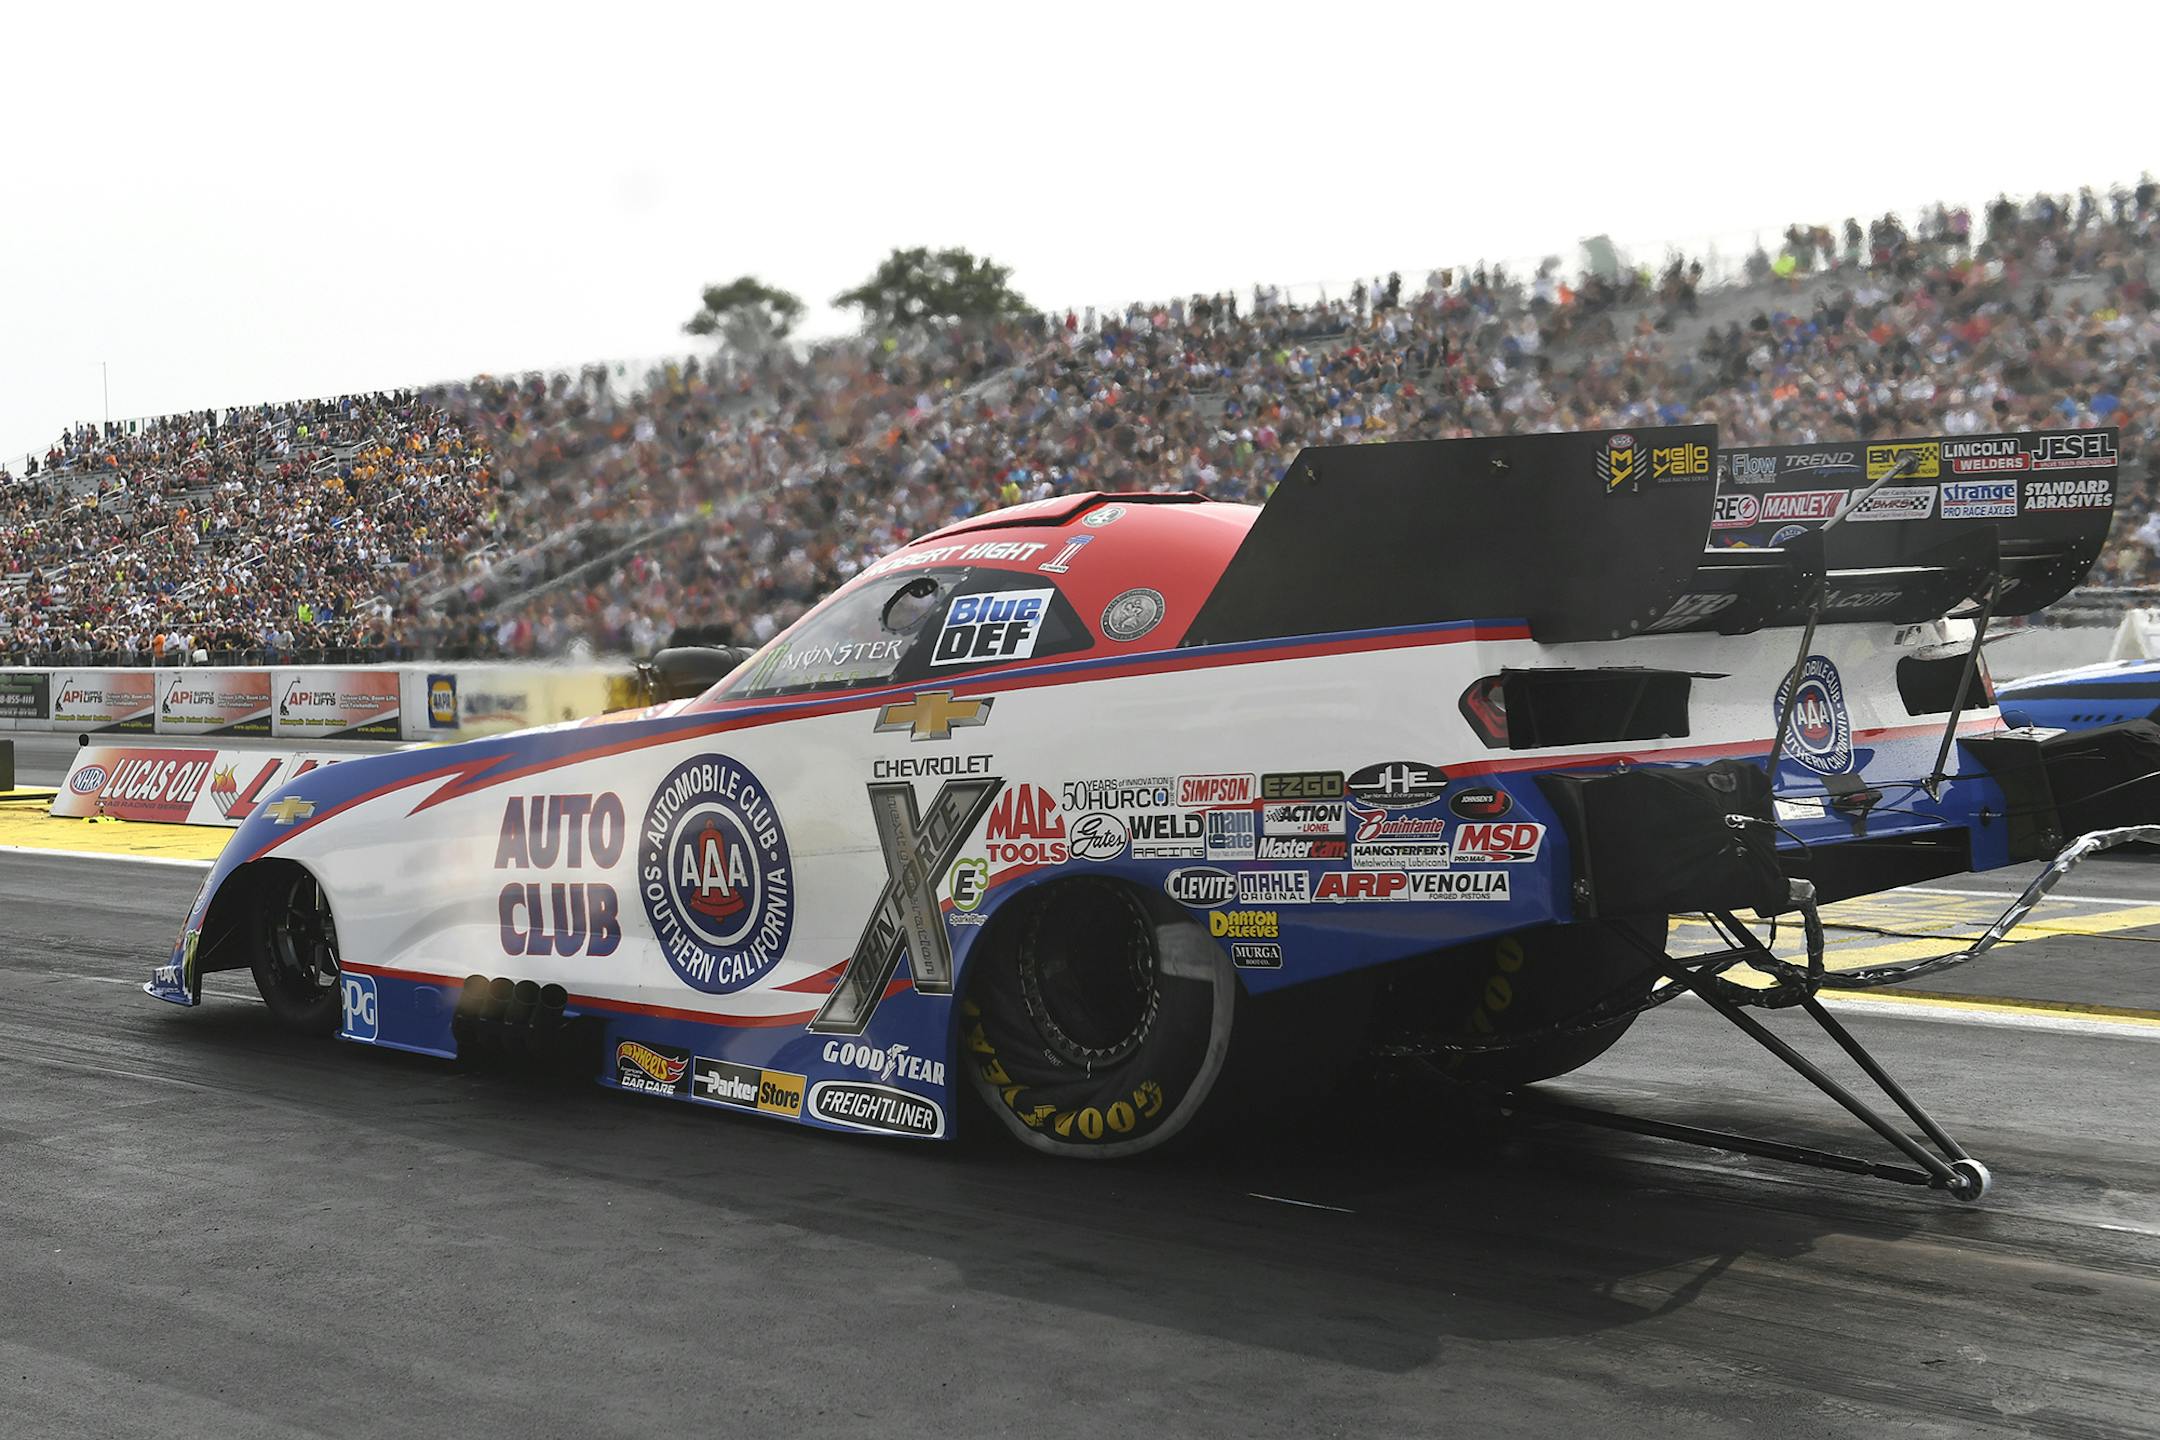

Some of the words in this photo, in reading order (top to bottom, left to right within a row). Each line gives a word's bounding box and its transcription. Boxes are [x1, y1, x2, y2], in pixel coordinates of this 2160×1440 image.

[1945, 441, 2015, 458] LINCOLN
[2031, 433, 2118, 460] JESEL
[1732, 453, 1777, 476] Flow
[1785, 452, 1855, 467] TREND
[1960, 457, 2023, 471] WELDERS
[2024, 480, 2110, 496] STANDARD
[1764, 495, 1832, 518] MANLEY
[1943, 506, 1961, 518] PRO
[1962, 505, 1986, 517] RACE
[1986, 504, 2016, 516] AXLES
[2024, 493, 2113, 510] ABRASIVES
[960, 542, 1049, 561] HIGHT
[948, 597, 1043, 626] Blue
[935, 621, 1032, 661] DEF
[193, 696, 215, 705] LIFTS
[313, 697, 337, 706] LIFTS
[1797, 700, 1831, 730] AAA
[873, 754, 994, 779] CHEVROLET
[73, 768, 105, 791] NHRA
[99, 758, 177, 801] LUCAS
[165, 760, 210, 802] OIL
[1086, 779, 1118, 791] YEARS
[1125, 776, 1169, 786] INNOVATION
[1181, 777, 1250, 803] SIMPSON
[647, 764, 741, 850] AUTOMOBILE
[739, 784, 778, 850] CLUB
[1062, 780, 1087, 812] 50
[1087, 787, 1169, 810] HURCO
[985, 783, 1067, 841] MAC
[1281, 805, 1343, 823] ACTION
[494, 791, 626, 870] AUTO
[1071, 817, 1124, 857] Gates
[1129, 814, 1204, 840] WELD
[1303, 823, 1330, 833] LIONEL
[1458, 824, 1539, 851] MSD
[985, 842, 1070, 863] TOOLS
[1133, 845, 1205, 858] RACING
[1257, 838, 1346, 859] Mastercam
[1353, 845, 1447, 856] HANGSTERFER'S
[680, 838, 749, 897] AAA
[1353, 857, 1407, 869] Metalworking
[1408, 856, 1448, 868] Lubricants
[1167, 871, 1236, 900] CLEVITE
[1240, 873, 1305, 893] MAHLE
[1315, 873, 1408, 897] ARP
[1411, 873, 1507, 893] VENOLIA
[851, 906, 897, 1015] JOHN
[891, 791, 962, 921] FORCE
[1241, 893, 1305, 901] ORIGINAL
[1461, 892, 1491, 900] PISTONS
[498, 882, 623, 958] CLUB
[644, 865, 716, 983] SOUTHERN
[718, 867, 788, 984] CALIFORNIA
[1209, 910, 1278, 937] DARTON
[1227, 926, 1279, 938] SLEEVES
[1235, 946, 1279, 958] MURGA
[822, 1040, 946, 1087] GOODYEAR
[621, 1076, 645, 1089] CAR
[645, 1080, 676, 1095] CARE
[706, 1070, 758, 1102] Parker
[759, 1082, 800, 1110] Store
[820, 1089, 934, 1131] FREIGHTLINER
